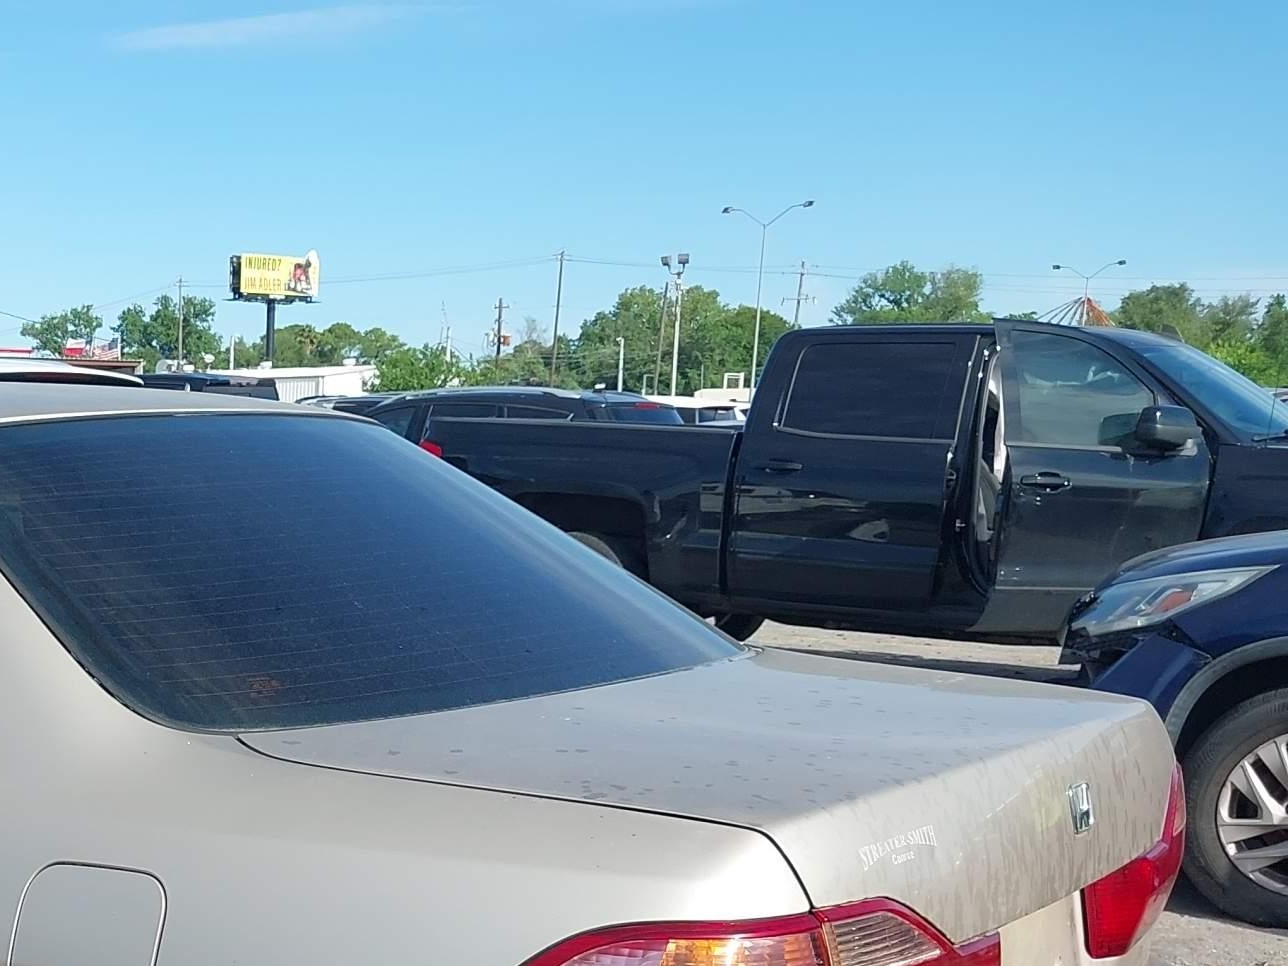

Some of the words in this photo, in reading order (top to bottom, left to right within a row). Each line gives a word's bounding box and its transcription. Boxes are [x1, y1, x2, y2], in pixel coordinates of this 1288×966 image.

[245, 256, 282, 272] INJURED?
[244, 276, 256, 290] JIM
[259, 277, 282, 292] ADLER
